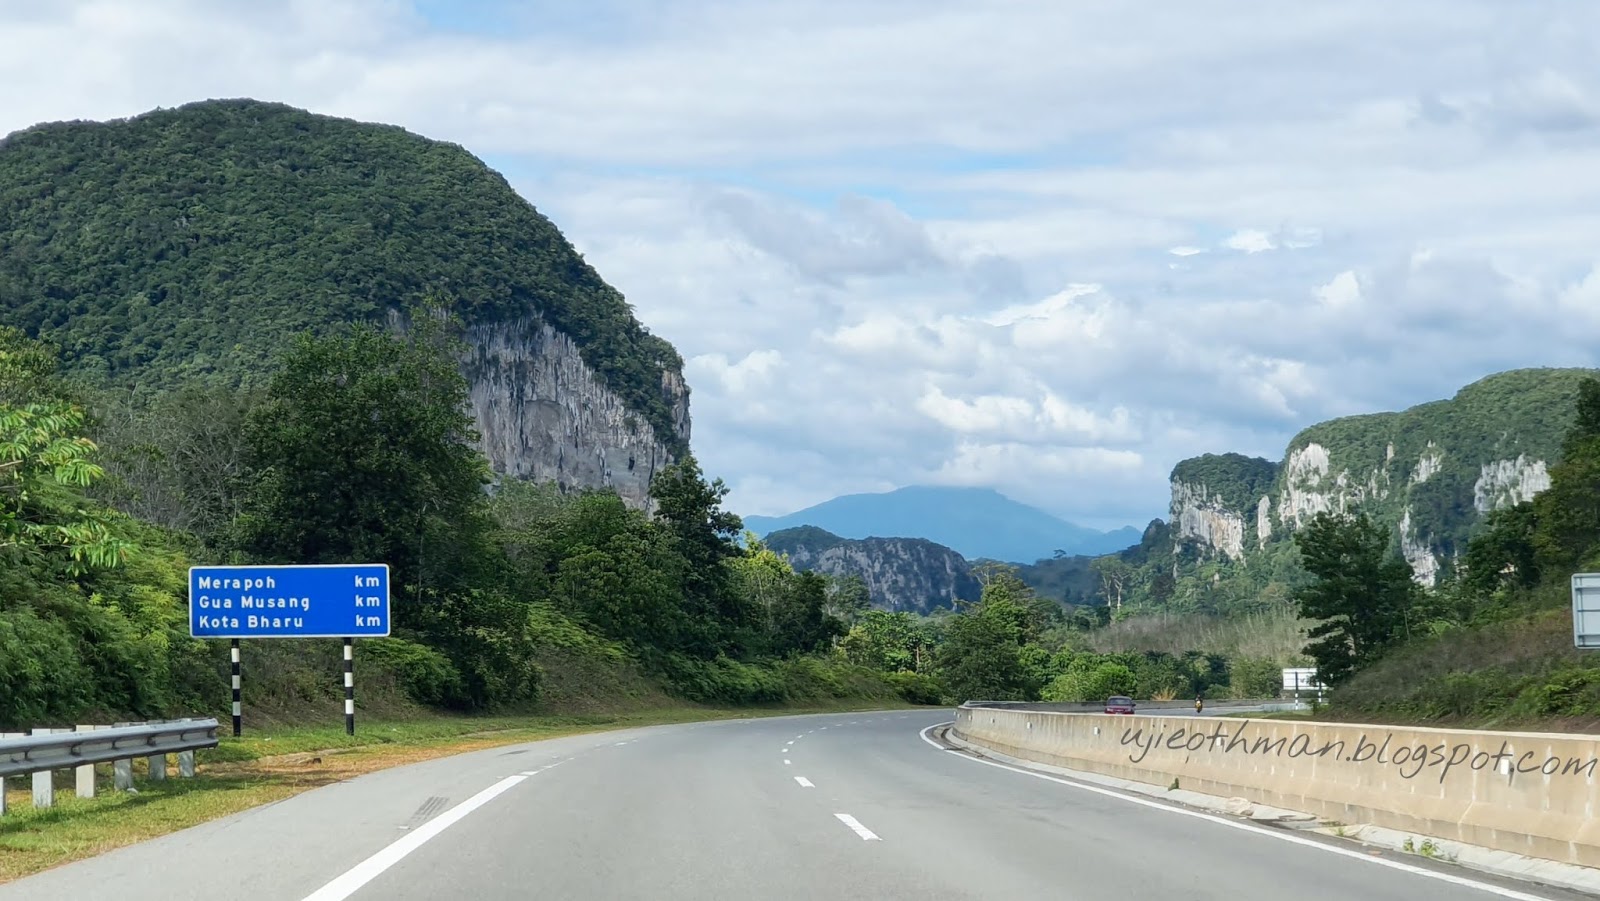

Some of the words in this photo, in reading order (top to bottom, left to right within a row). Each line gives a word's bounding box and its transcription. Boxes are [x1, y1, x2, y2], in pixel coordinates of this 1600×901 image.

[198, 576, 276, 591] Merapoh
[354, 575, 380, 588] km
[199, 596, 232, 609] Gua
[241, 595, 310, 612] Musang
[355, 595, 381, 607] km
[199, 615, 239, 628] Kota
[247, 615, 303, 628] Bharu
[355, 614, 381, 627] km
